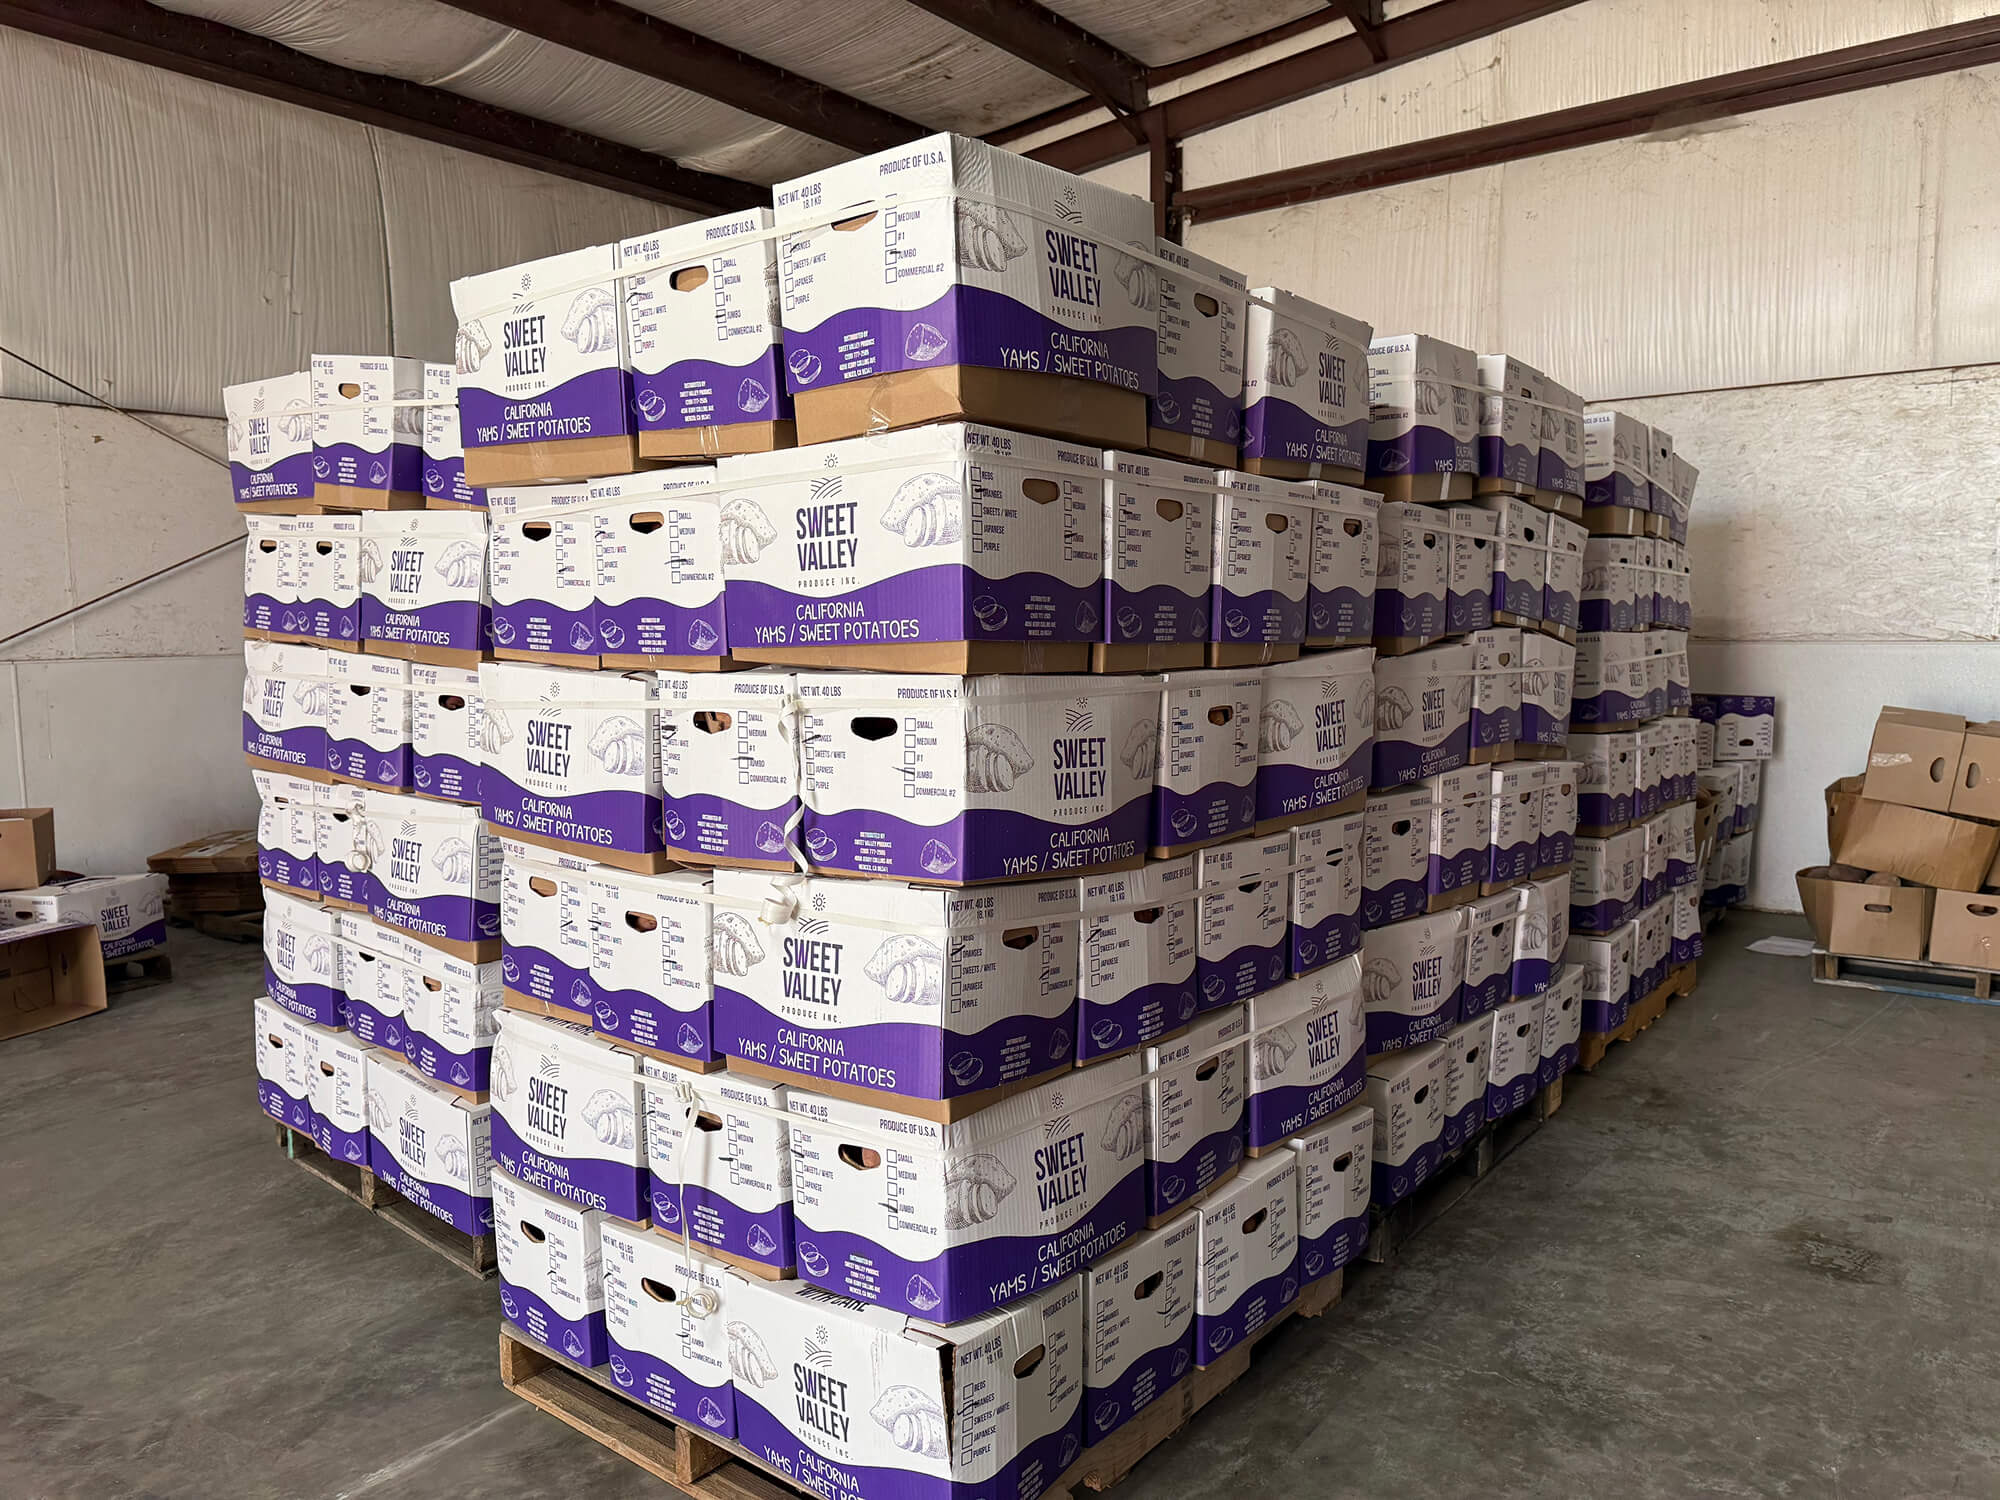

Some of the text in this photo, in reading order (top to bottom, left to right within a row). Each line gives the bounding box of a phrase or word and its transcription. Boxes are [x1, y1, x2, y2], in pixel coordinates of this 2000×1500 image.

[880, 151, 946, 176] PRODUCE OF U.S.A.
[778, 193, 789, 206] NET
[801, 186, 809, 198] 40
[810, 183, 821, 196] LBS
[898, 211, 920, 222] MEDIUM
[1046, 230, 1098, 265] SWEET
[793, 258, 809, 270] SWEETS
[813, 253, 826, 264] WHITE
[898, 263, 944, 278] COMMERCIAL #2
[795, 275, 814, 288] JAPANESE
[1049, 266, 1101, 307] VALLEY
[795, 293, 810, 304] PURPLE
[504, 315, 545, 349] SWEET
[1051, 332, 1109, 362] CALIFORNIA
[505, 347, 546, 377] VALLEY
[1000, 347, 1039, 370] YAMS
[1054, 355, 1092, 376] SWEET
[1095, 362, 1140, 390] POTATOES
[1319, 352, 1345, 380] SWEET
[1319, 381, 1346, 408] VALLEY
[504, 402, 552, 421] CALIFORNIA
[477, 426, 499, 442] YAMS
[506, 422, 535, 440] SWEET
[538, 416, 591, 436] POTATOES
[1315, 429, 1348, 449] CALIFORNIA
[250, 436, 270, 455] VALLEY
[1058, 450, 1078, 464] PRODUCE
[1080, 454, 1086, 466] OF
[1286, 442, 1306, 458] YAMS
[1315, 446, 1337, 461] SWEET
[1338, 449, 1361, 467] POTATOES
[250, 472, 273, 484] CALIFORNIA
[982, 471, 993, 480] REDS
[678, 511, 692, 521] SMALL
[796, 501, 856, 540] SWEET
[678, 526, 696, 536] MEDIUM
[984, 525, 1004, 534] JAPANESE
[796, 539, 858, 572] VALLEY
[984, 542, 1000, 551] PURPLE
[391, 550, 424, 572] SWEET
[390, 574, 422, 594] VALLEY
[798, 579, 836, 588] PRODUCE
[385, 613, 420, 626] CALIFORNIA
[796, 602, 865, 620] CALIFORNIA
[385, 627, 450, 644] SWEET POTATOES
[755, 626, 787, 644] YAMS
[799, 622, 840, 641] SWEET
[844, 620, 920, 639] POTATOES
[263, 678, 285, 700] SWEET
[800, 686, 810, 696] NET
[822, 687, 829, 696] 40
[831, 687, 841, 696] LBS
[1422, 688, 1445, 712] SWEET
[262, 699, 284, 718] VALLEY
[1315, 699, 1345, 728] SWEET
[1422, 710, 1445, 732] VALLEY
[258, 732, 282, 747] CALIFORNIA
[527, 720, 570, 752] SWEET
[749, 729, 767, 737] MEDIUM
[1315, 725, 1347, 752] VALLEY
[526, 749, 570, 778] VALLEY
[1053, 737, 1106, 770] SWEET
[750, 775, 779, 783] COMMERCIAL
[1054, 769, 1106, 801] VALLEY
[1314, 768, 1349, 789] CALIFORNIA
[916, 788, 948, 796] COMMERCIAL
[1282, 797, 1307, 814] YAMS
[1315, 788, 1341, 808] SWEET
[1342, 776, 1364, 802] POTATOES
[522, 797, 573, 819] CALIFORNIA
[494, 806, 515, 825] YAMS
[523, 811, 552, 835] SWEET
[556, 820, 613, 844] POTATOES
[391, 838, 422, 863] SWEET
[1050, 827, 1110, 849] CALIFORNIA
[1003, 856, 1038, 875] YAMS
[1052, 848, 1094, 869] SWEET
[1097, 840, 1135, 864] POTATOES
[391, 863, 421, 884] VALLEY
[101, 904, 128, 922] SWEET
[386, 898, 420, 916] CALIFORNIA
[951, 900, 964, 912] NET
[976, 898, 983, 909] 40
[984, 897, 994, 908] LBS
[102, 917, 130, 933] VALLEY
[386, 911, 446, 937] SWEET POTATOES
[783, 937, 843, 975] SWEET
[1412, 957, 1442, 982] SWEET
[784, 969, 841, 1007] VALLEY
[1412, 977, 1441, 1001] VALLEY
[782, 1005, 820, 1021] PRODUCE
[961, 1000, 978, 1008] PURPLE
[1306, 1010, 1339, 1045] SWEET
[1409, 1014, 1442, 1032] CALIFORNIA
[777, 1028, 844, 1057] CALIFORNIA
[1308, 1039, 1341, 1070] VALLEY
[738, 1037, 767, 1060] YAMS
[779, 1047, 819, 1075] SWEET
[823, 1057, 896, 1088] POTATOES
[528, 1076, 568, 1114] SWEET
[1308, 1078, 1345, 1105] CALIFORNIA
[1281, 1115, 1302, 1135] YAMS
[1310, 1099, 1336, 1123] SWEET
[1334, 1079, 1363, 1113] POTATOES
[400, 1118, 425, 1149] SWEET
[527, 1107, 566, 1140] VALLEY
[880, 1119, 908, 1133] PRODUCE
[909, 1124, 917, 1134] OF
[400, 1138, 426, 1167] VALLEY
[522, 1150, 569, 1180] CALIFORNIA
[1034, 1132, 1084, 1180] SWEET
[400, 1171, 430, 1196] CALIFORNIA
[522, 1166, 607, 1211] SWEET POTATOES
[1037, 1164, 1087, 1212] VALLEY
[1038, 1220, 1094, 1262] CALIFORNIA
[989, 1274, 1027, 1304] YAMS
[1041, 1251, 1078, 1284] SWEET
[1080, 1221, 1126, 1267] POTATOES
[794, 1363, 848, 1401] SWEET
[796, 1396, 849, 1443] VALLEY
[974, 1425, 996, 1442] JAPANESE
[973, 1444, 991, 1458] PURPLE
[764, 1445, 792, 1474] YAMS
[802, 1469, 837, 1500] SWEET
[799, 1450, 859, 1492] CALIFORNIA
